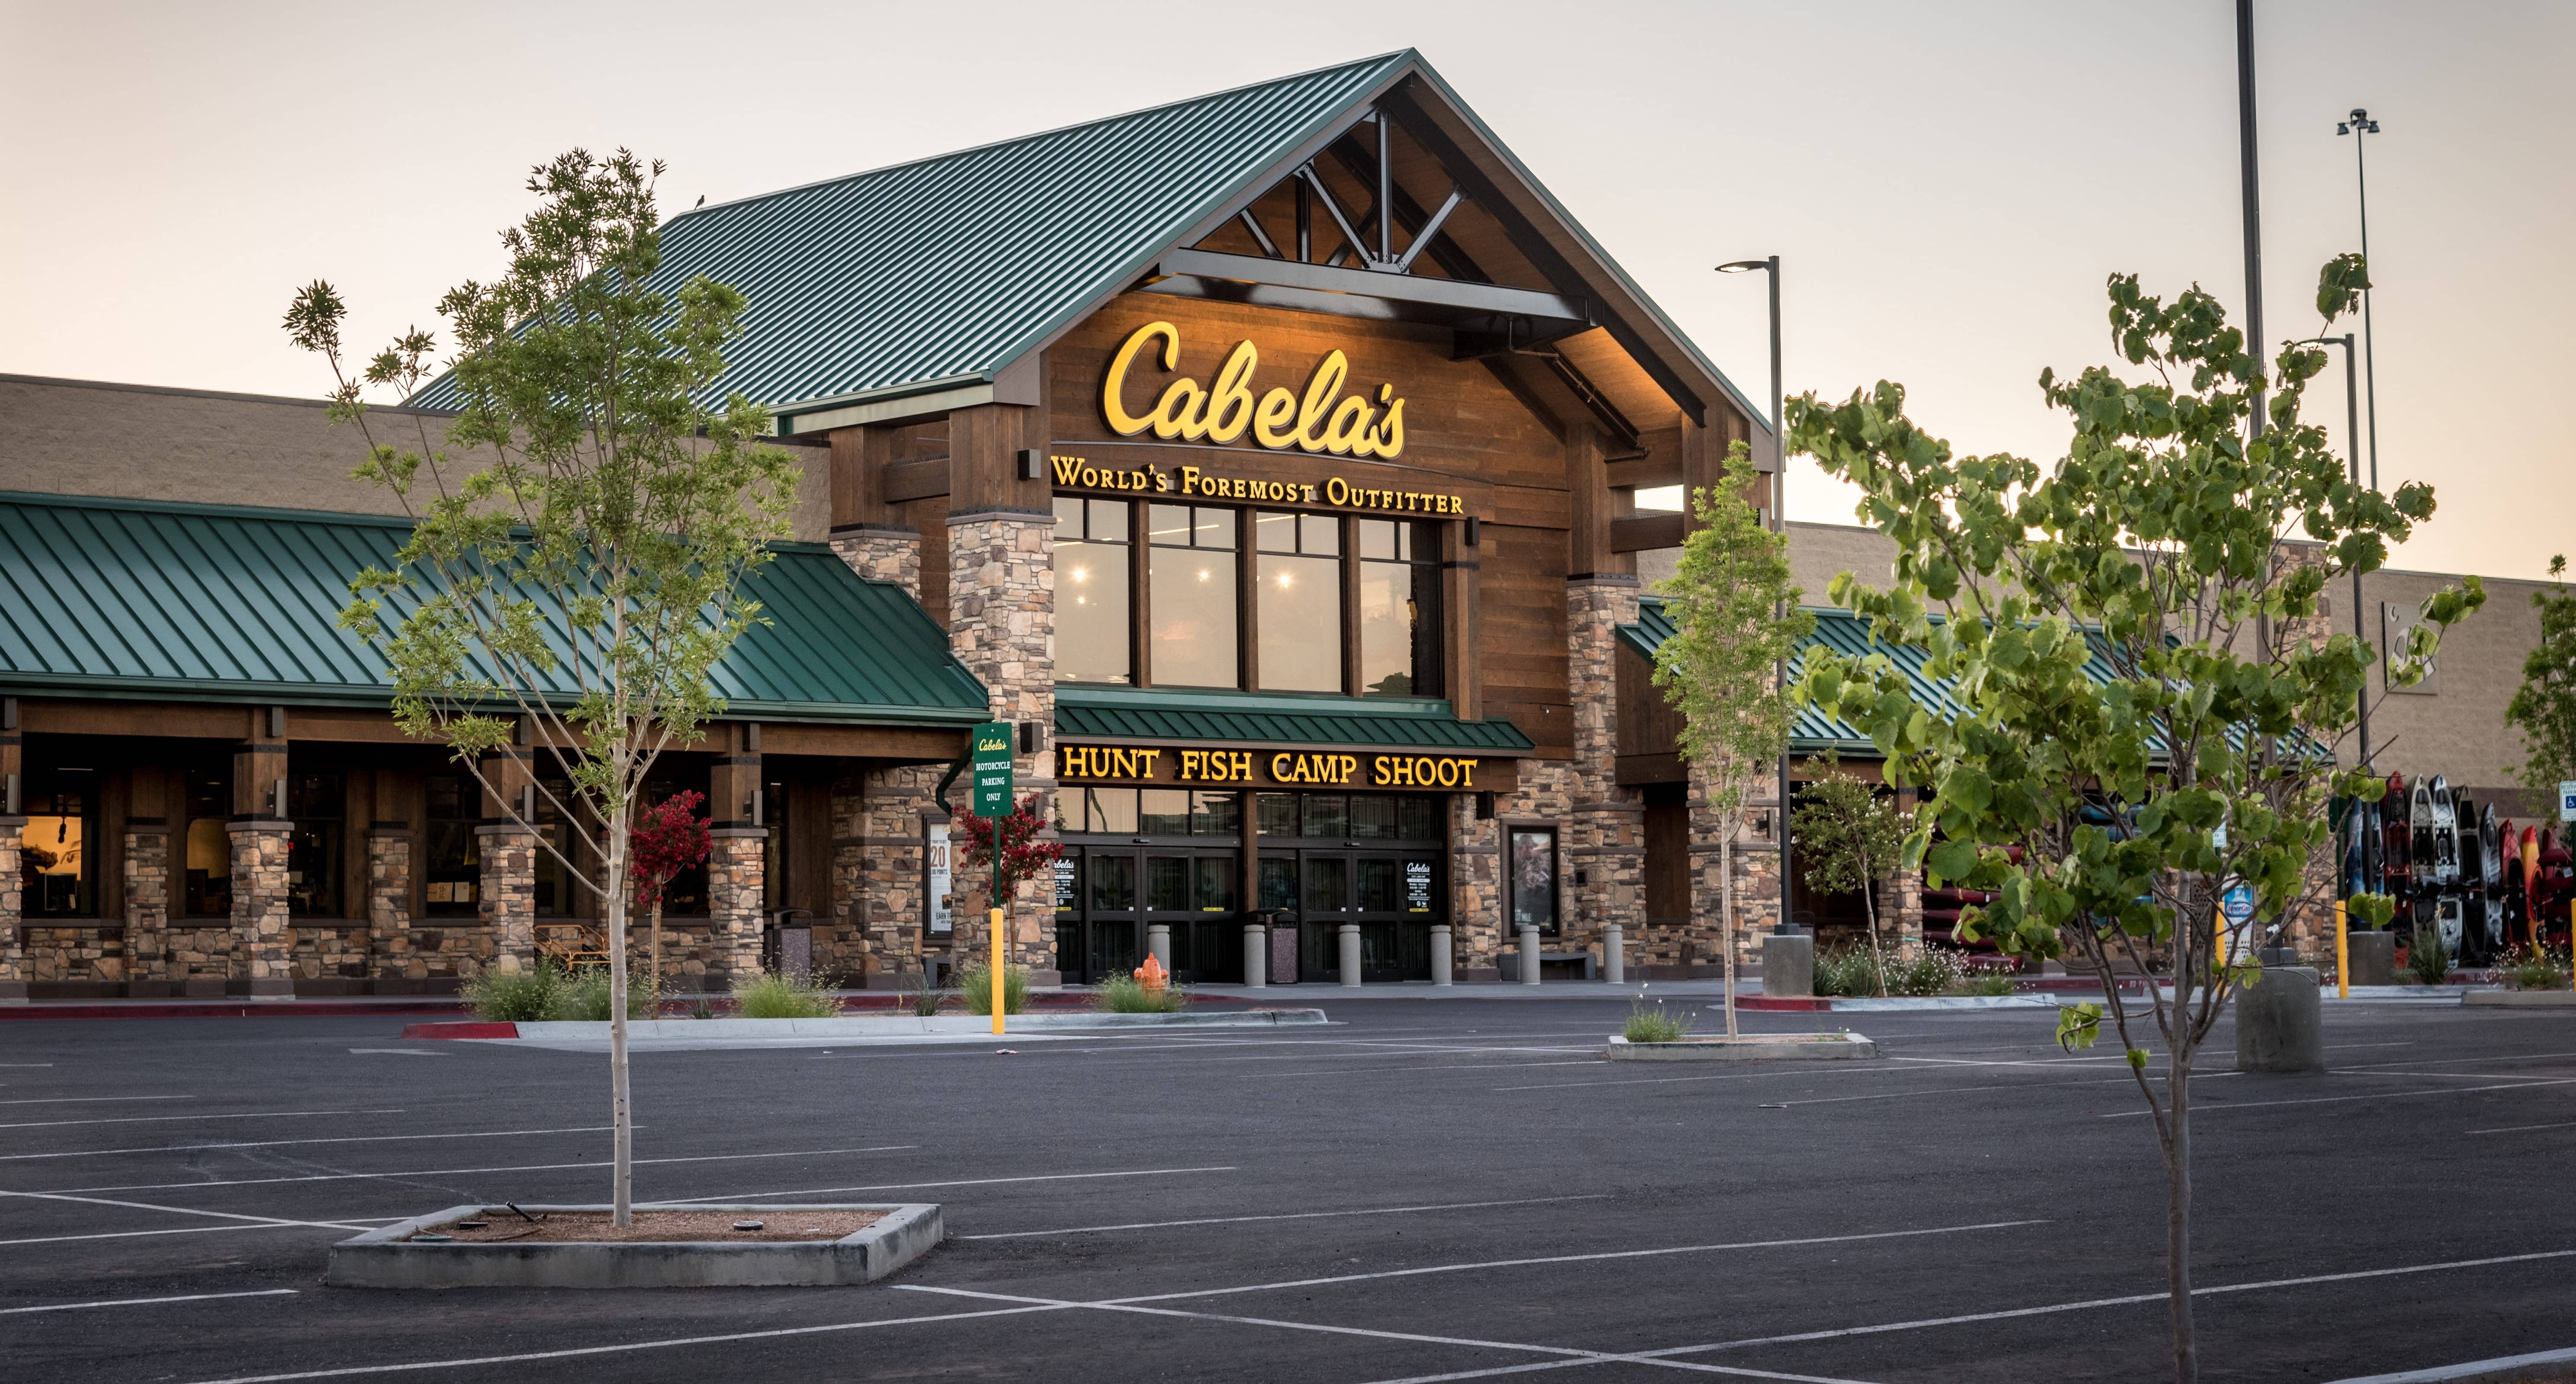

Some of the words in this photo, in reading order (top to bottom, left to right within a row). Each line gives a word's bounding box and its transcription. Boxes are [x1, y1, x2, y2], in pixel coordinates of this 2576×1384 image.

[1104, 320, 1406, 458] Cabela's
[979, 739, 1007, 751] Cabela's
[976, 761, 1010, 771] MOTORCYCLE
[1064, 747, 1160, 778] HUNT
[1181, 751, 1253, 781] FISH
[1272, 753, 1357, 783] CAMP
[1375, 756, 1478, 786] SHOOT
[982, 777, 1005, 786] PARKING
[986, 793, 1001, 801] ONLY
[930, 846, 945, 868] 20
[1054, 859, 1074, 868] bela's
[1407, 862, 1429, 872] Cabela's
